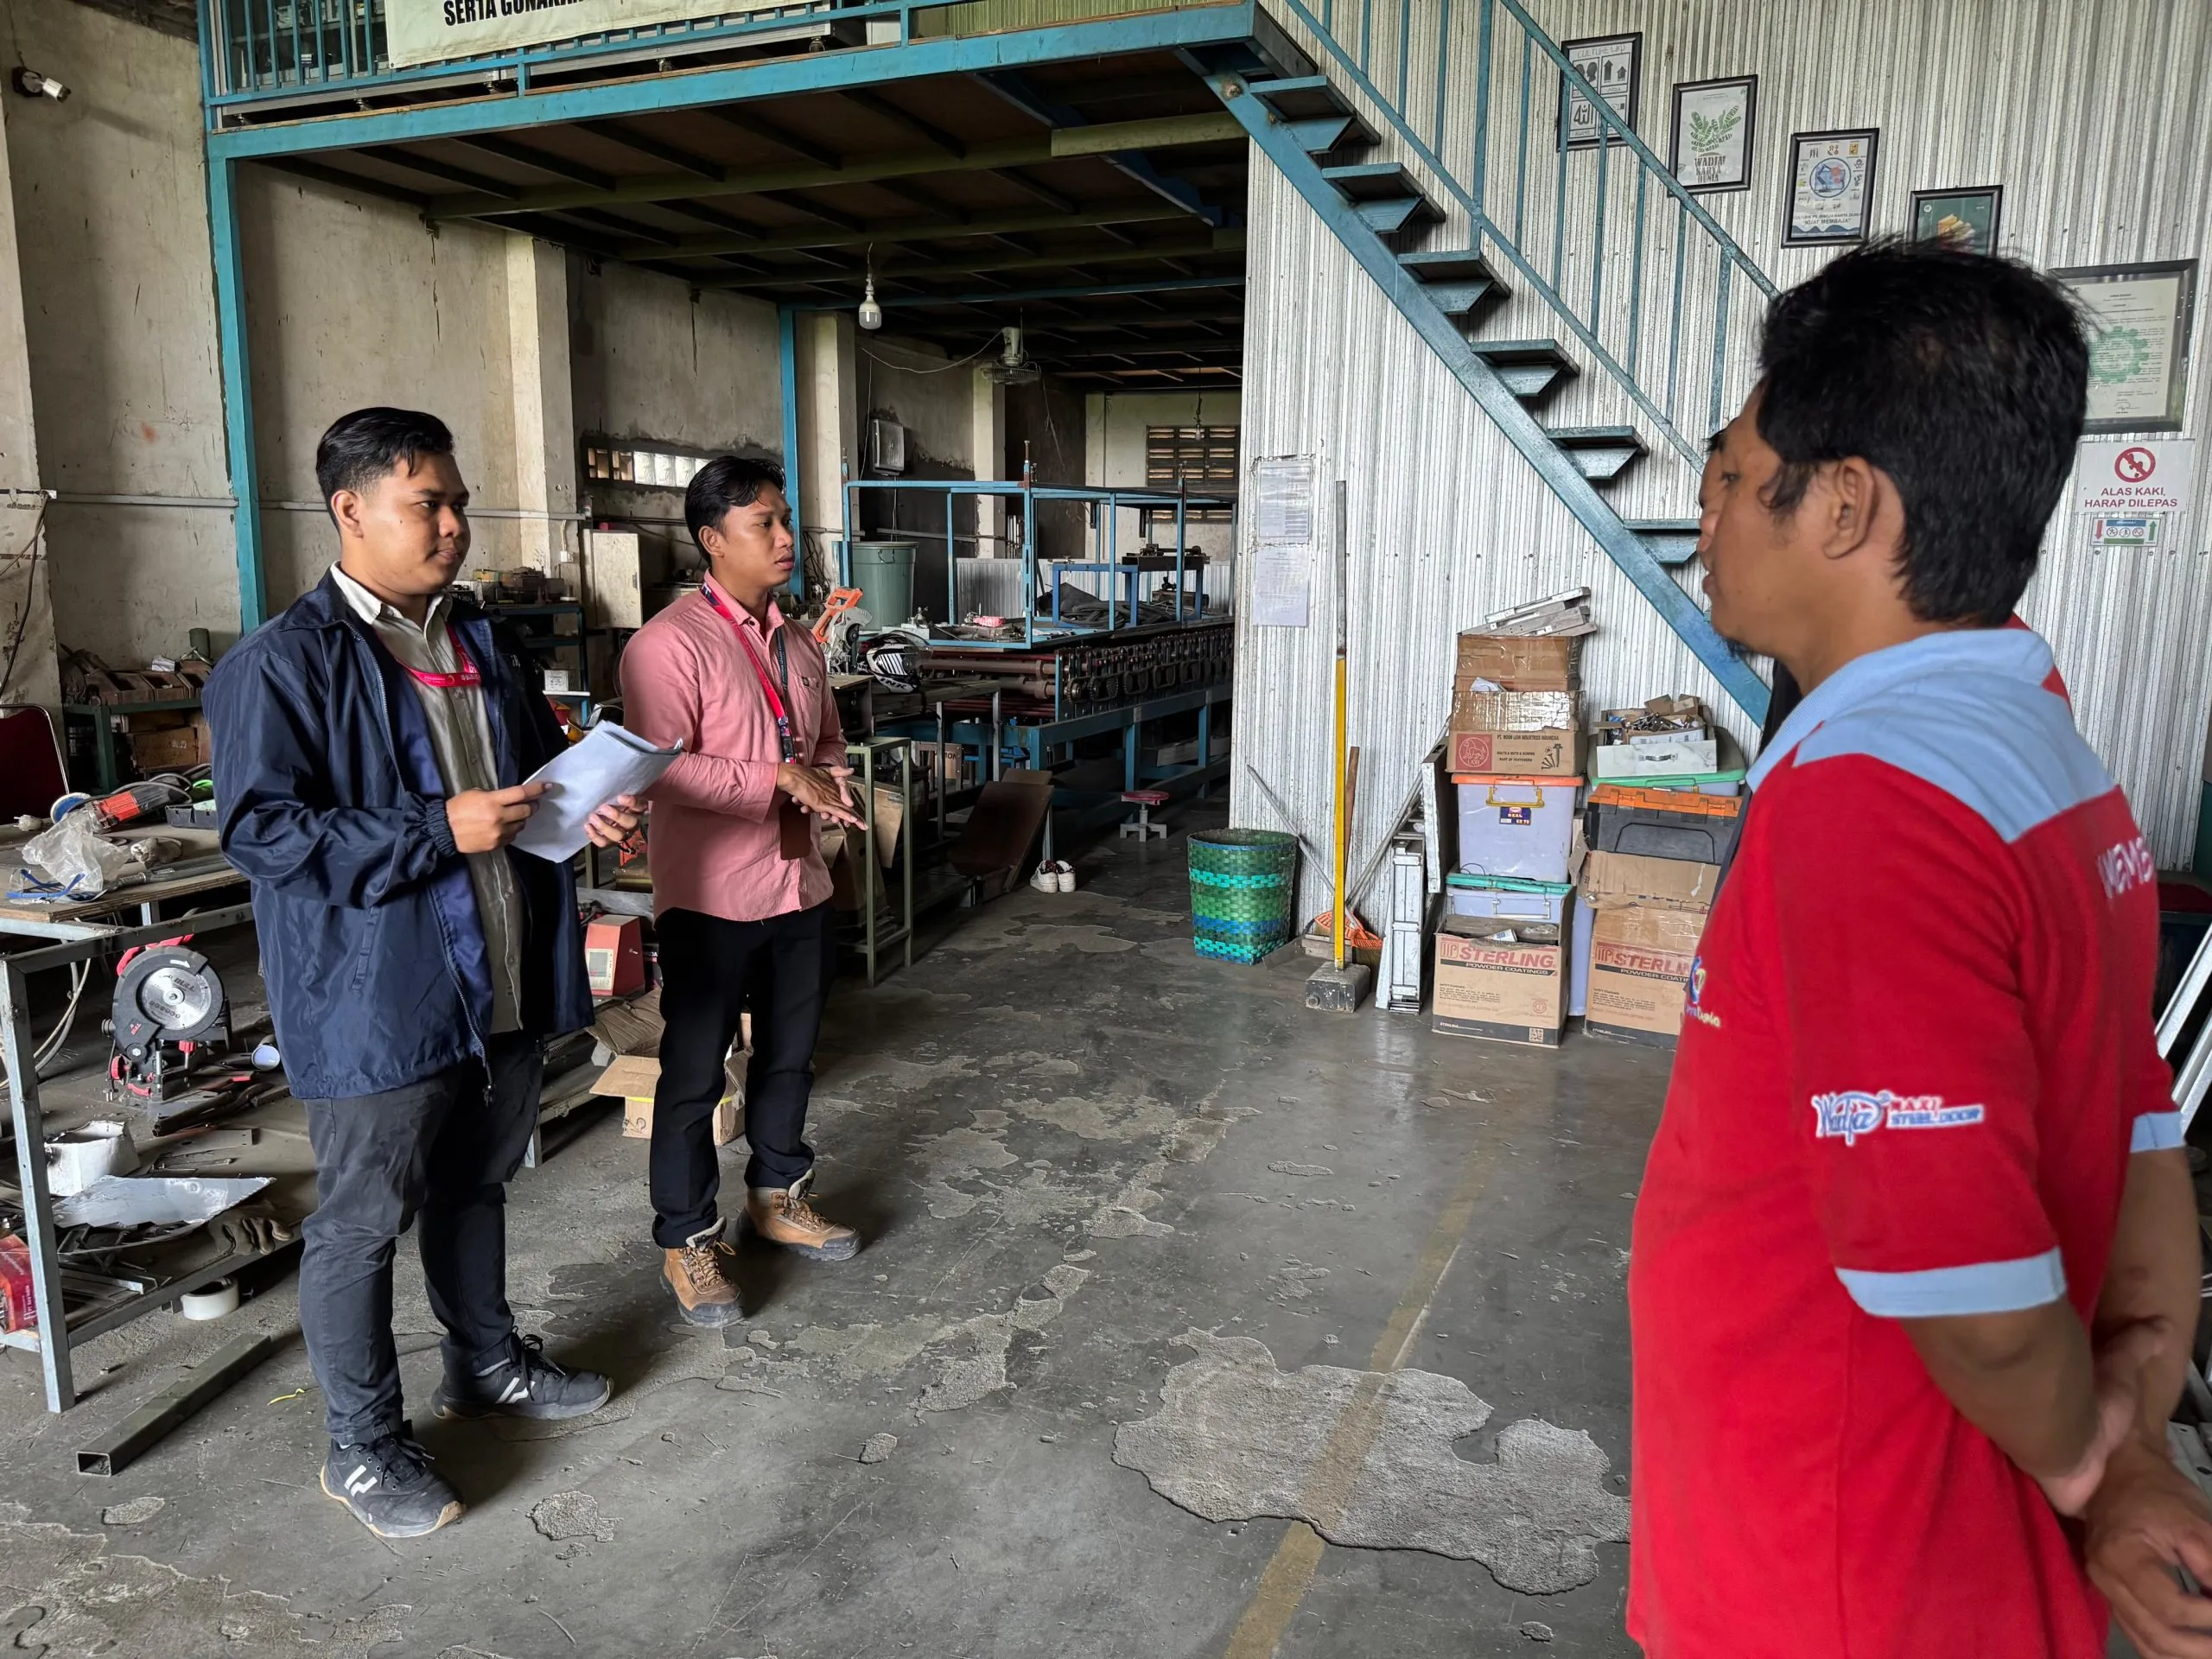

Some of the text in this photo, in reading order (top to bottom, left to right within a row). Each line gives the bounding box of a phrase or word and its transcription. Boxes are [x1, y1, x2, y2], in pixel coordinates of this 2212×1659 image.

[443, 0, 497, 26] SERTA
[2101, 487, 2132, 496] ALAS
[2084, 499, 2177, 508] HARAP DILEPAS
[1459, 946, 1554, 968] STERLING
[1465, 963, 1548, 976] POWDER COATINGS
[1620, 969, 1660, 979] POWDER
[174, 977, 195, 992] BULL
